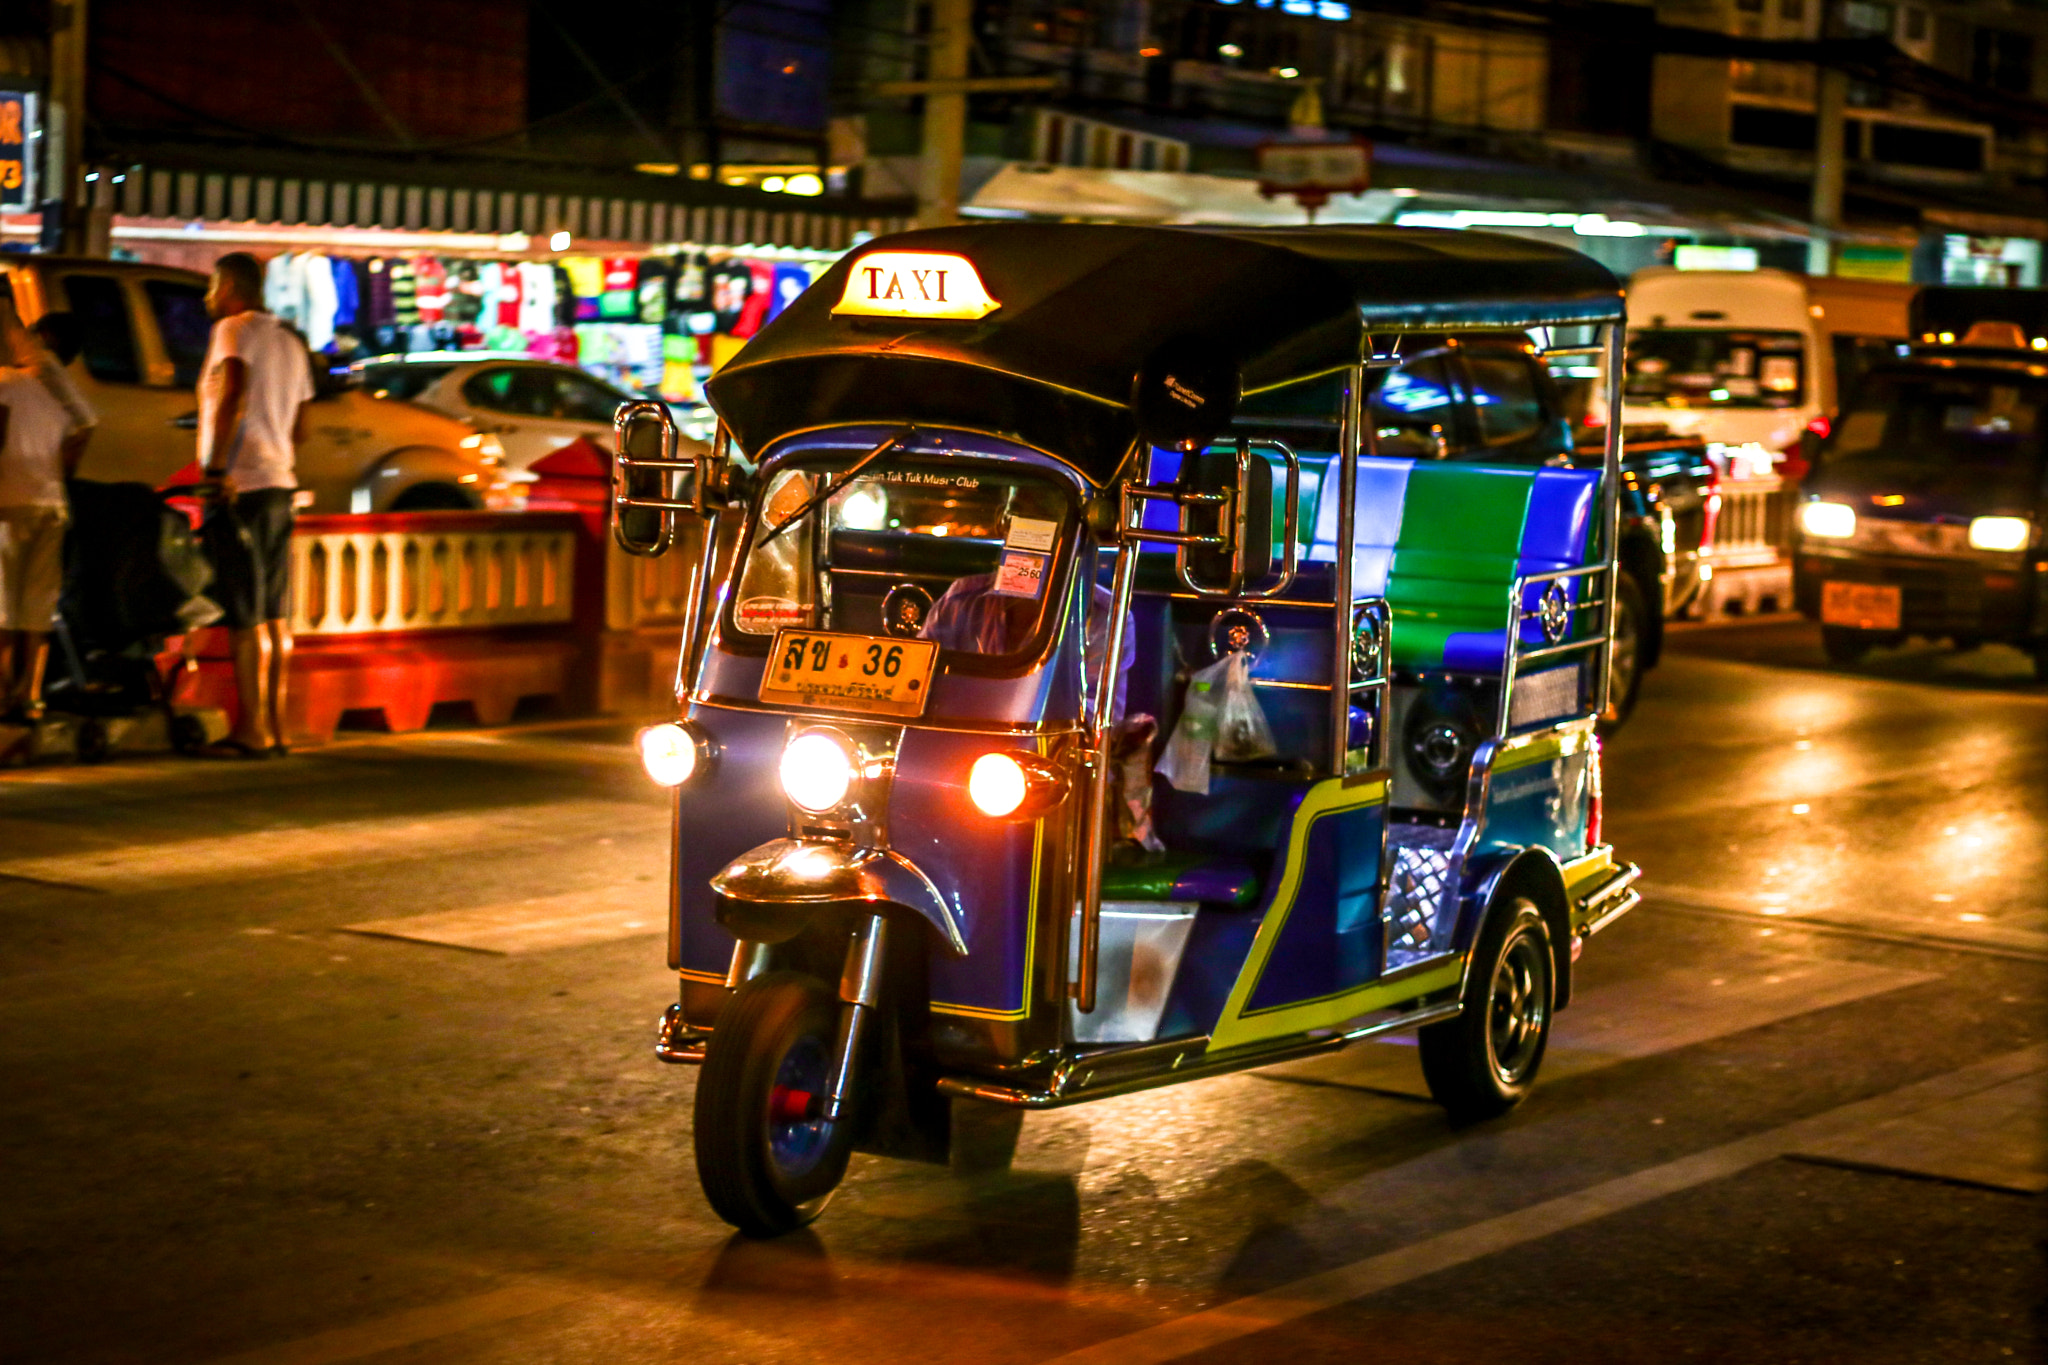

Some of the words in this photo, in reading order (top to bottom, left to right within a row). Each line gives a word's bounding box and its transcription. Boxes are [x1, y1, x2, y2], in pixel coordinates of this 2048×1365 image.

[862, 266, 948, 302] TAXI
[887, 471, 902, 482] Tuk
[905, 472, 921, 483] Tuk
[956, 476, 979, 488] Club
[862, 644, 903, 677] 36
